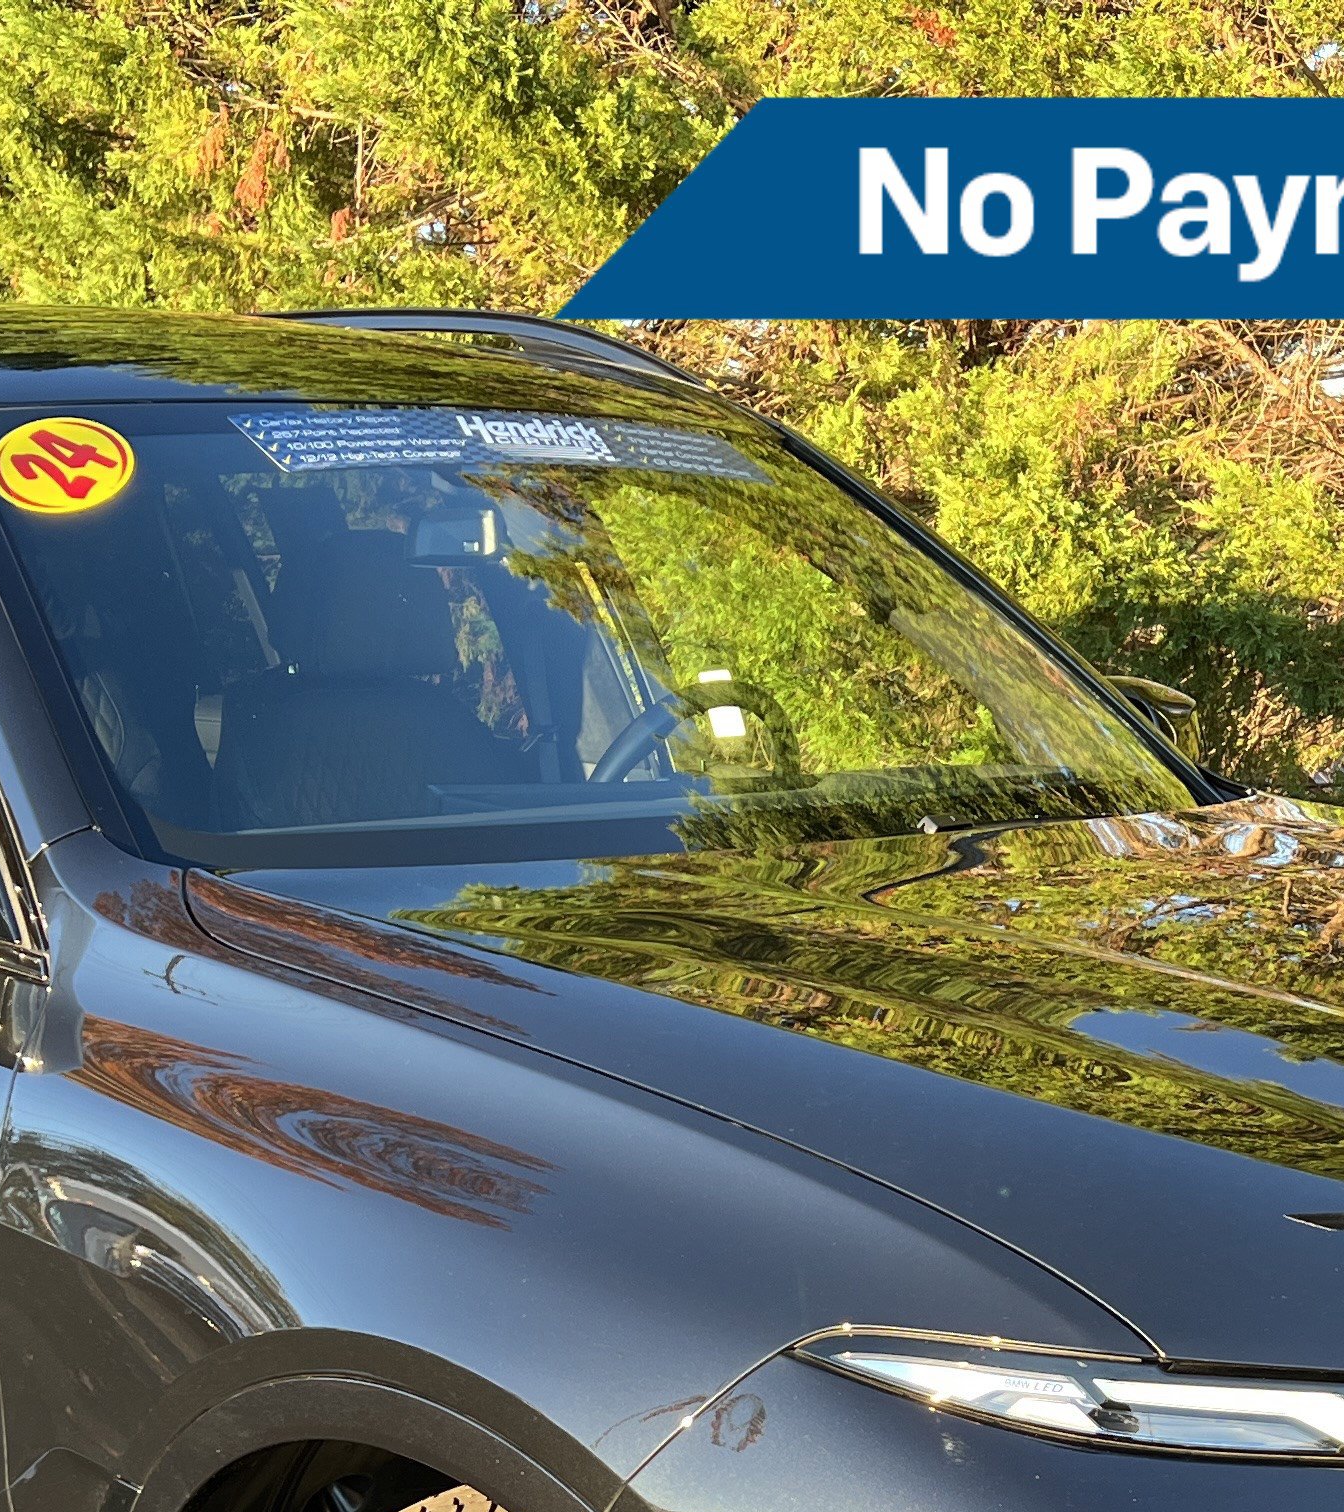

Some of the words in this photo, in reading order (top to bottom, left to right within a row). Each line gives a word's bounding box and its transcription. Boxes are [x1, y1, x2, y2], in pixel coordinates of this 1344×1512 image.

[456, 415, 604, 445] Hendrick
[286, 441, 334, 451] 10/100
[299, 453, 339, 463] 12/12
[402, 449, 462, 459] Coverage
[10, 430, 118, 499] 24
[1033, 1383, 1064, 1393] LED
